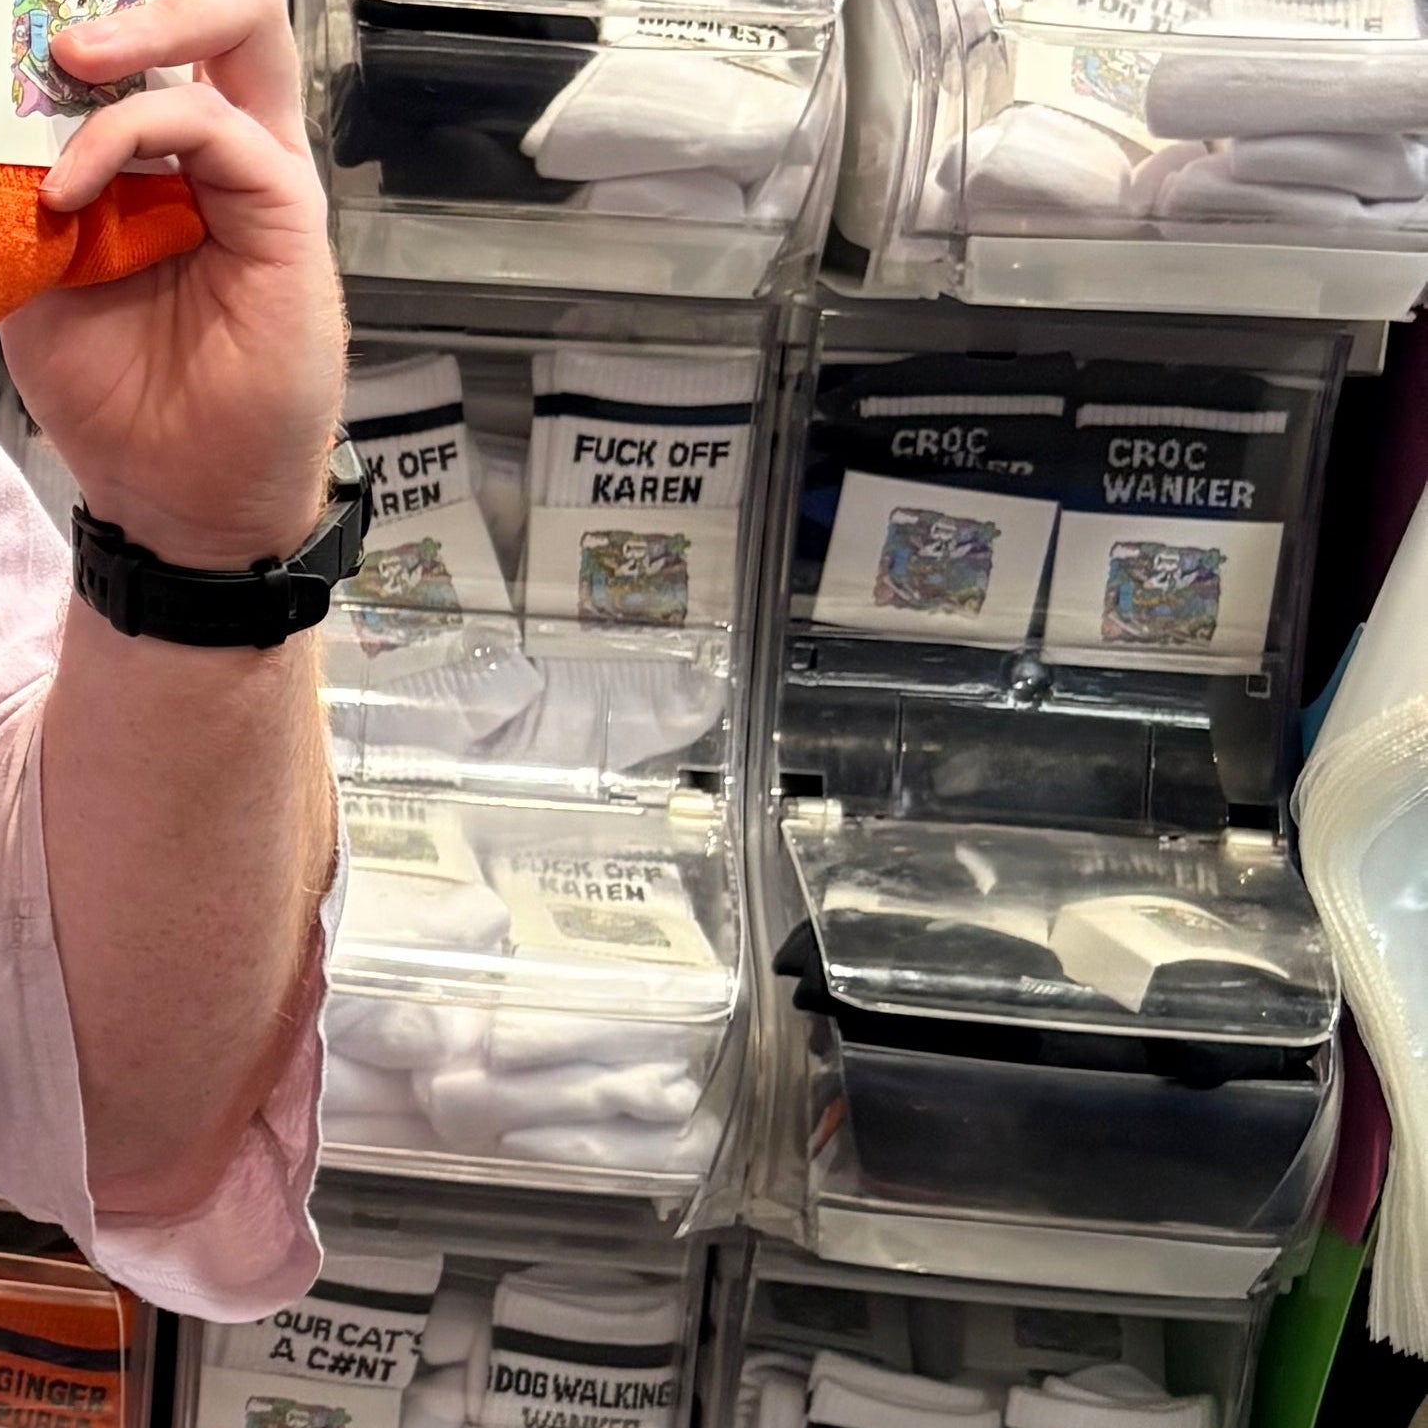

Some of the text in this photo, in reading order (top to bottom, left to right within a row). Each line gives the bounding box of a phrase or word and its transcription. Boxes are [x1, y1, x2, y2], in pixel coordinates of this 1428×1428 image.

[572, 433, 732, 470] FUCK OFF
[890, 425, 990, 458] CROC
[1106, 436, 1209, 472] CROC
[397, 440, 459, 480] OFF
[591, 473, 704, 505] KAREN
[1100, 472, 1257, 510] WANKER
[256, 1308, 333, 1342] OUR
[269, 1336, 397, 1383] A C#NT
[553, 1374, 676, 1410] WALKING
